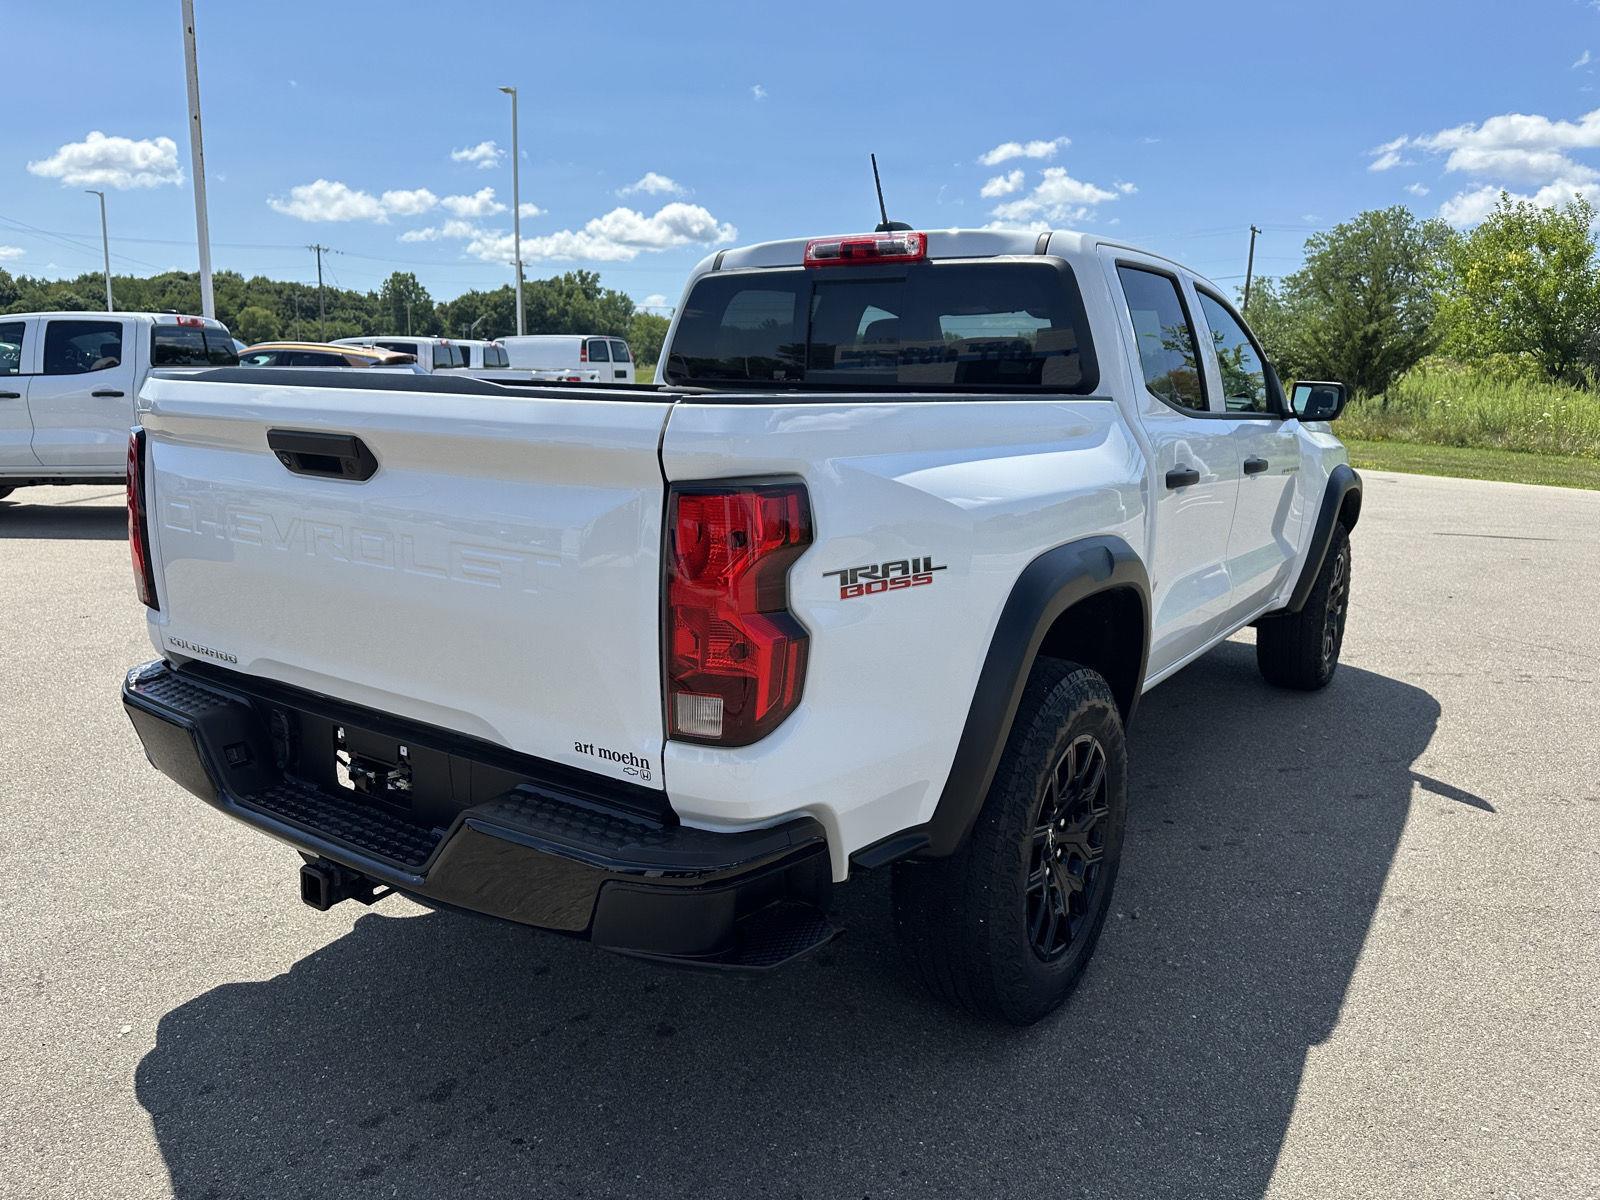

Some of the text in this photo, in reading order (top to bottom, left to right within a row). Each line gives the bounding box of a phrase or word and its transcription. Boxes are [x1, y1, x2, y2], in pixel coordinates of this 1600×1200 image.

[164, 497, 562, 594] CHEVROLET
[822, 556, 948, 586] TRAIL
[840, 572, 933, 600] BOSS
[167, 636, 238, 664] COLORADO
[574, 741, 651, 770] art moehn
